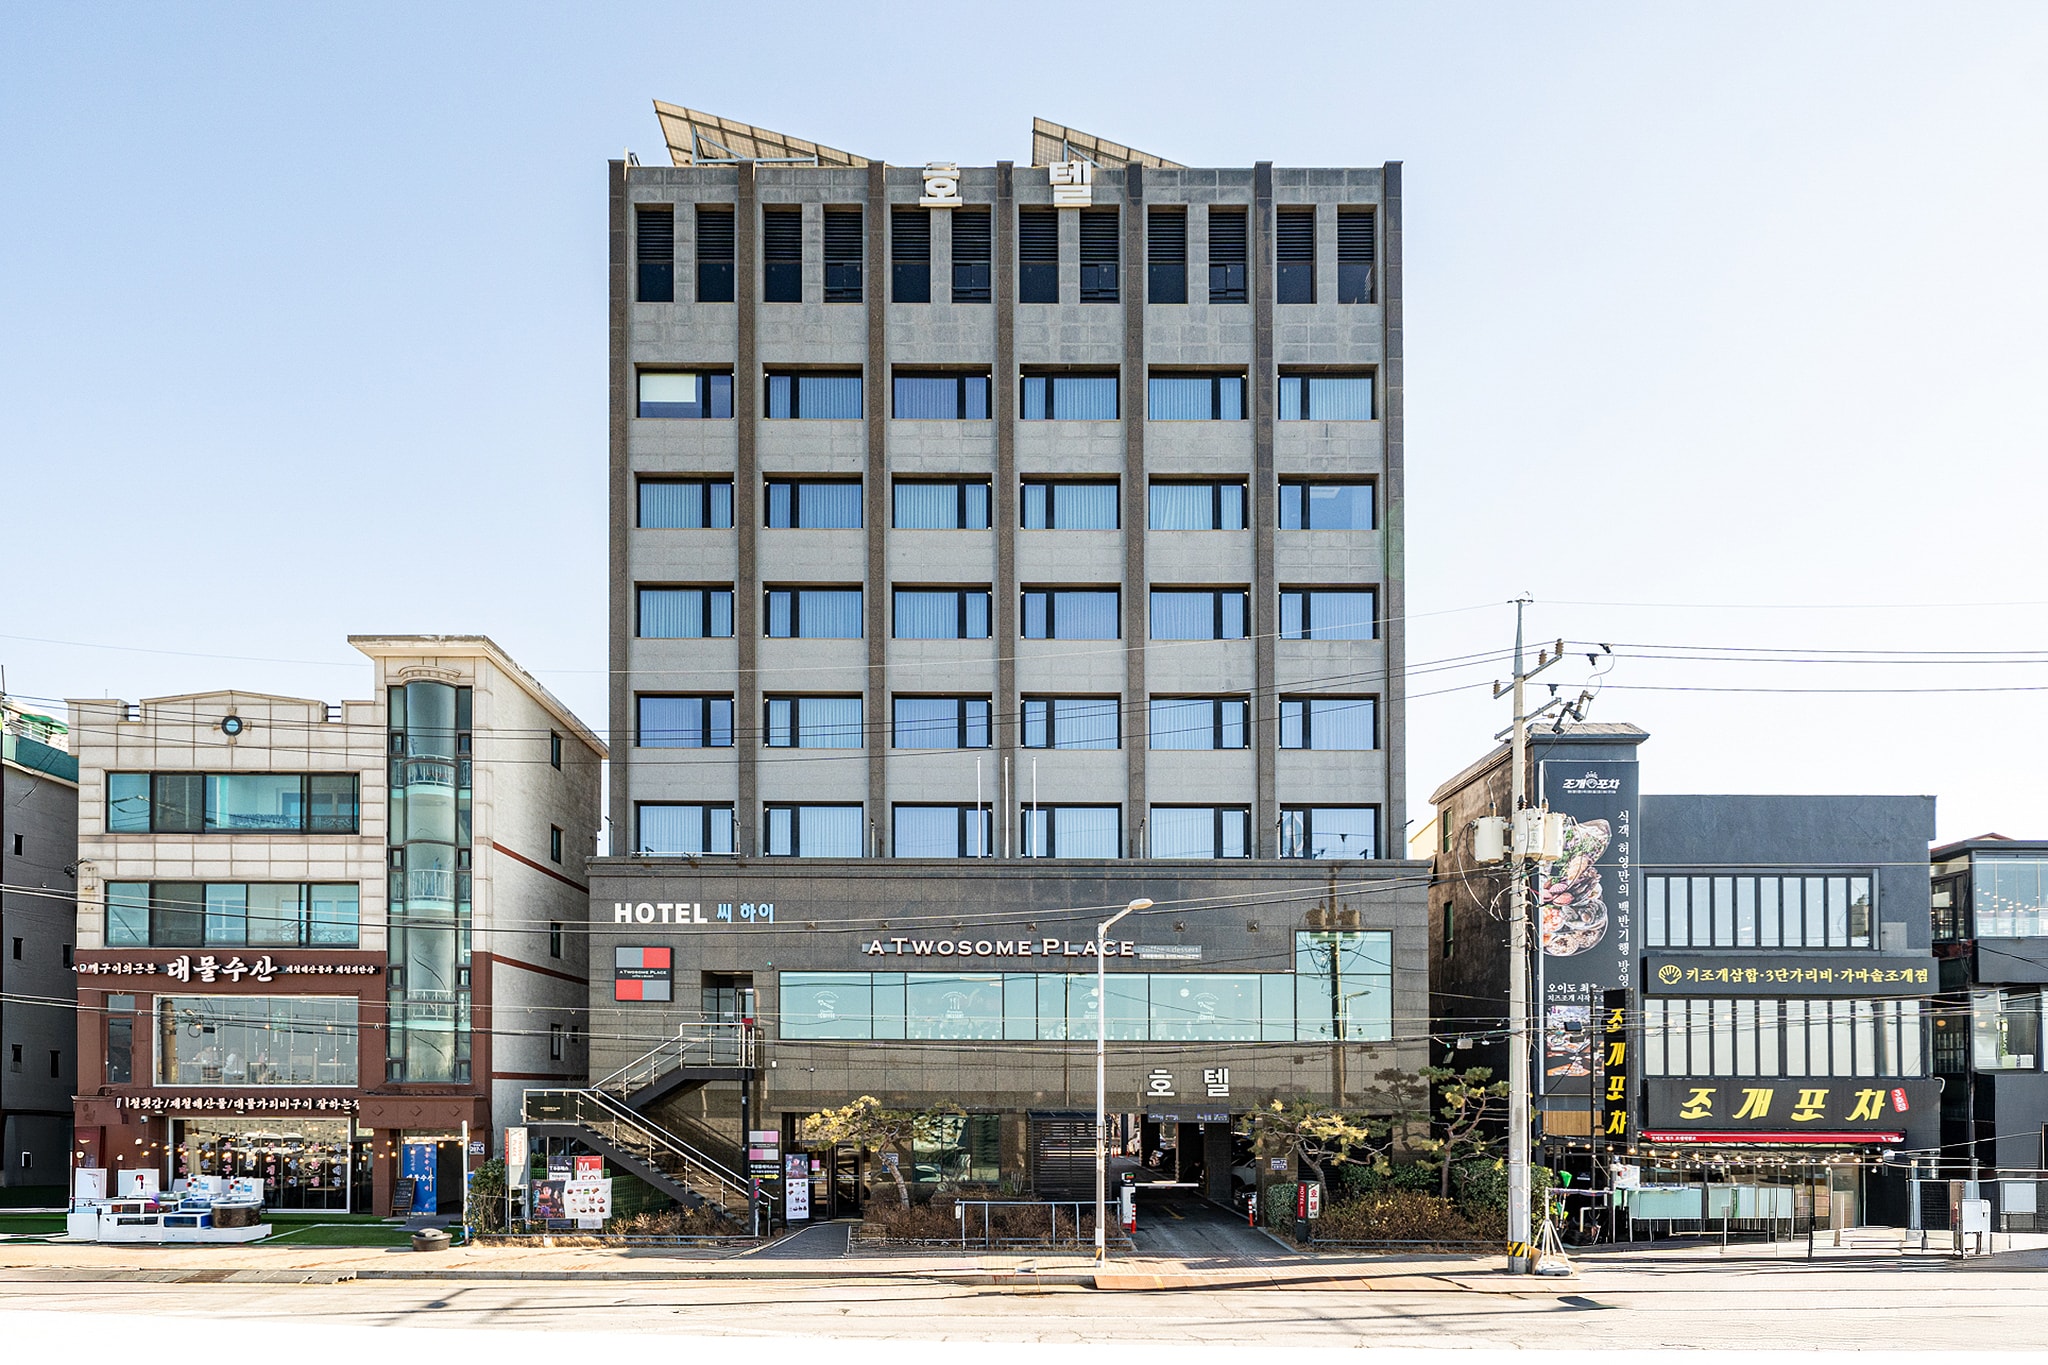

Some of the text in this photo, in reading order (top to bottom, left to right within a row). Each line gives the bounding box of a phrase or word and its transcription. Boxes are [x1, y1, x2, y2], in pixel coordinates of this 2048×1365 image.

[1617, 841, 1630, 897] 허영만의
[614, 902, 708, 924] HOTEL
[1617, 900, 1630, 956] 백반기행
[867, 937, 1135, 957] A TWOSOME PLACE
[1171, 945, 1199, 953] dessert
[166, 954, 278, 983] 대물수산
[1617, 959, 1630, 987] 방영
[1547, 982, 1577, 994] 오이도
[1604, 1007, 1628, 1135] 조개포차
[1679, 1088, 1886, 1122] 조개포차
